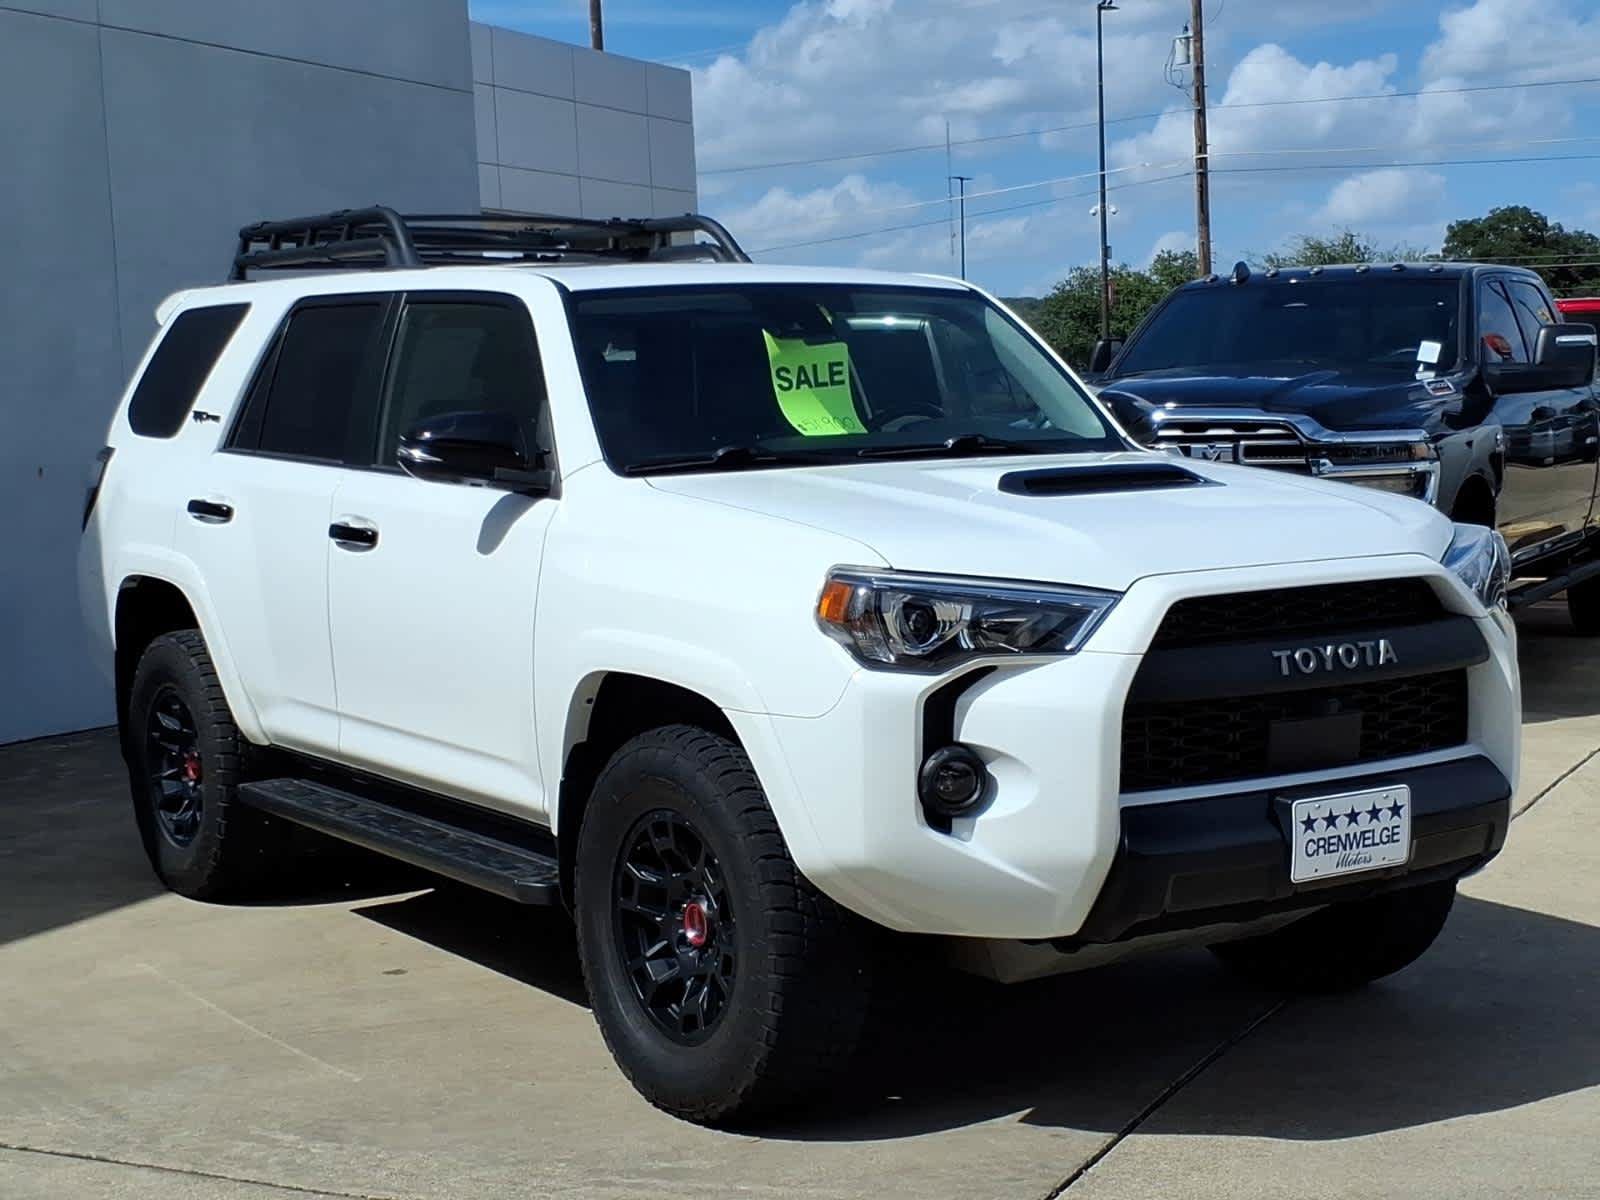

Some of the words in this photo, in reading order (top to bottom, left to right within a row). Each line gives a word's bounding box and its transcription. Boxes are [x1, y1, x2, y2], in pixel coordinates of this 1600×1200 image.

[775, 361, 845, 392] SALE
[1271, 639, 1398, 675] TOYOTA
[1304, 825, 1401, 858] CRENWELGE
[1335, 852, 1372, 869] Motors
